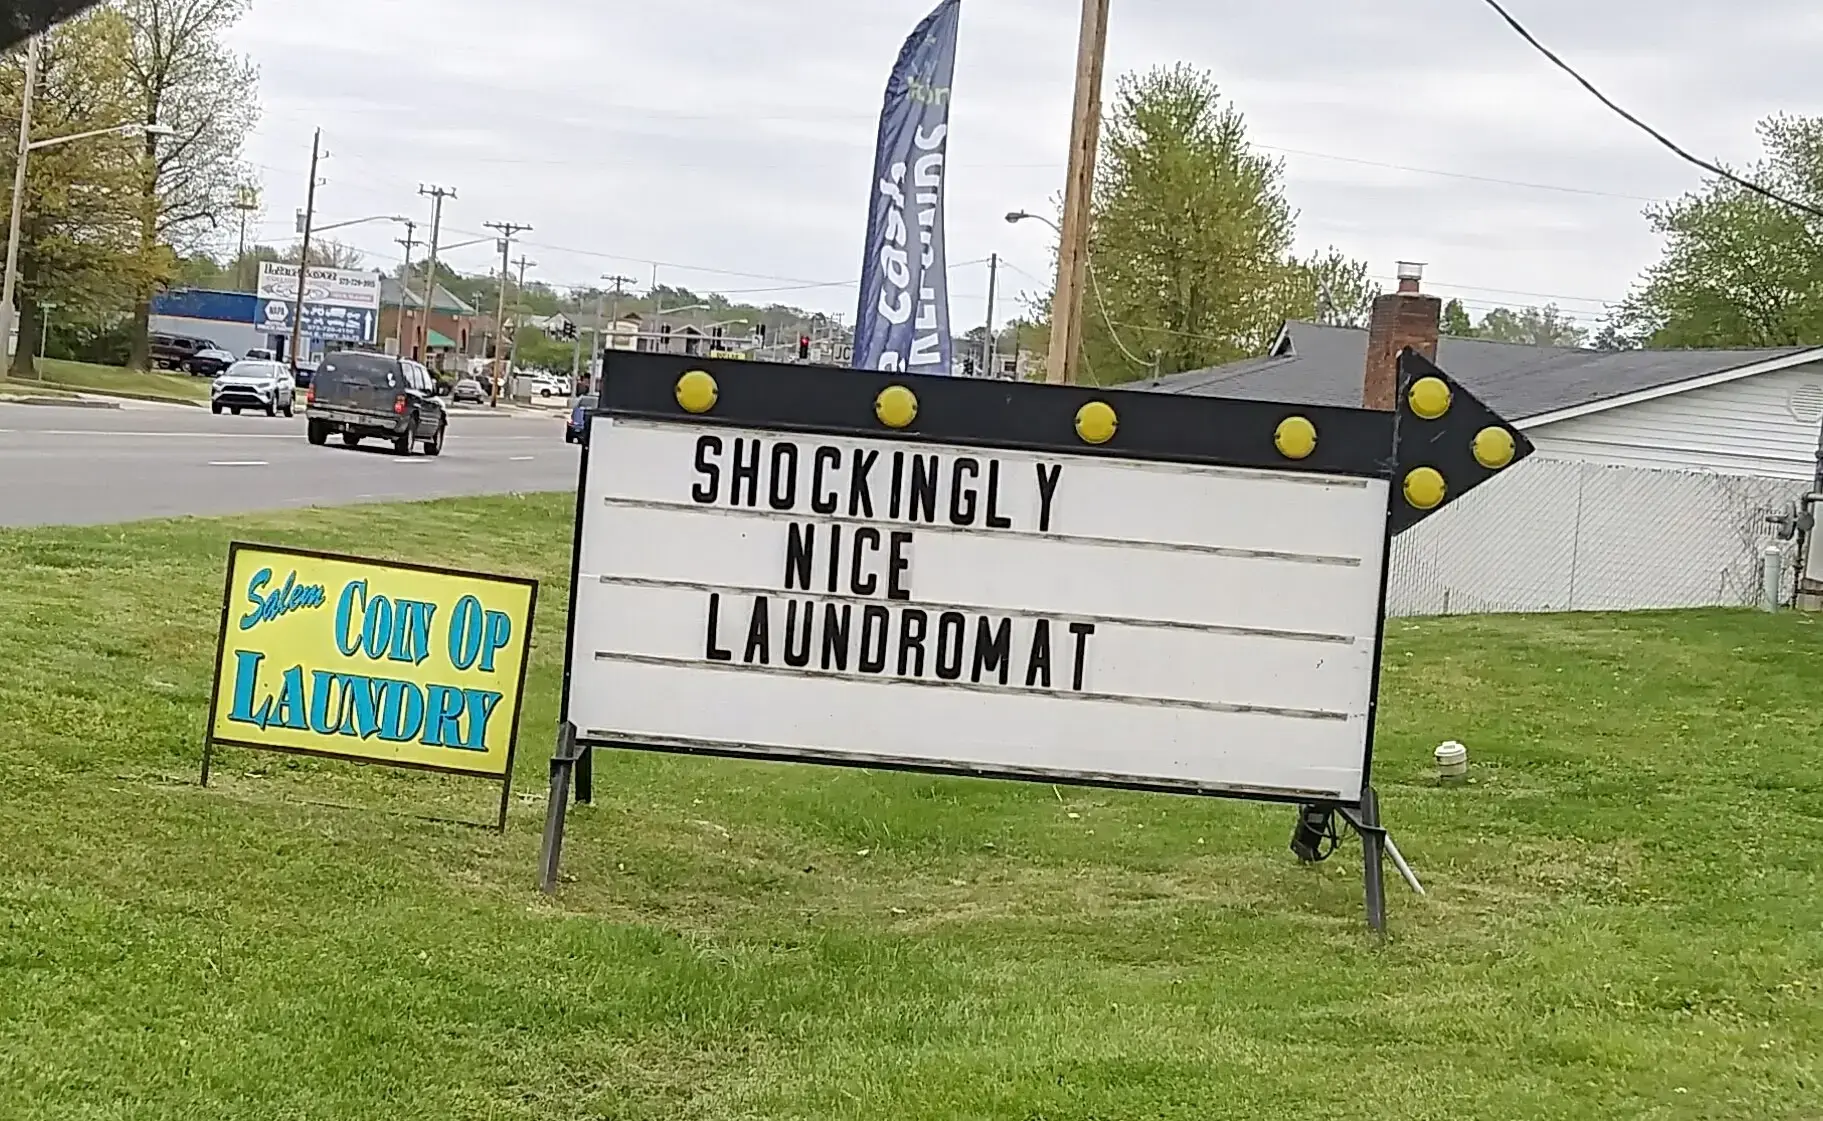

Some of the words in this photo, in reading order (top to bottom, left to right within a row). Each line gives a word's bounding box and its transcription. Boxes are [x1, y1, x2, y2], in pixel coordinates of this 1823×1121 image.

[268, 305, 285, 316] NAPA
[834, 344, 851, 361] JC
[692, 435, 1062, 531] SHOCKINGLY
[784, 522, 913, 600] NICE
[239, 567, 326, 630] Salem
[335, 578, 436, 666] COIN
[448, 595, 512, 672] OP
[705, 593, 1095, 690] LAUNDROMAT
[228, 649, 504, 752] LAUNDRY
